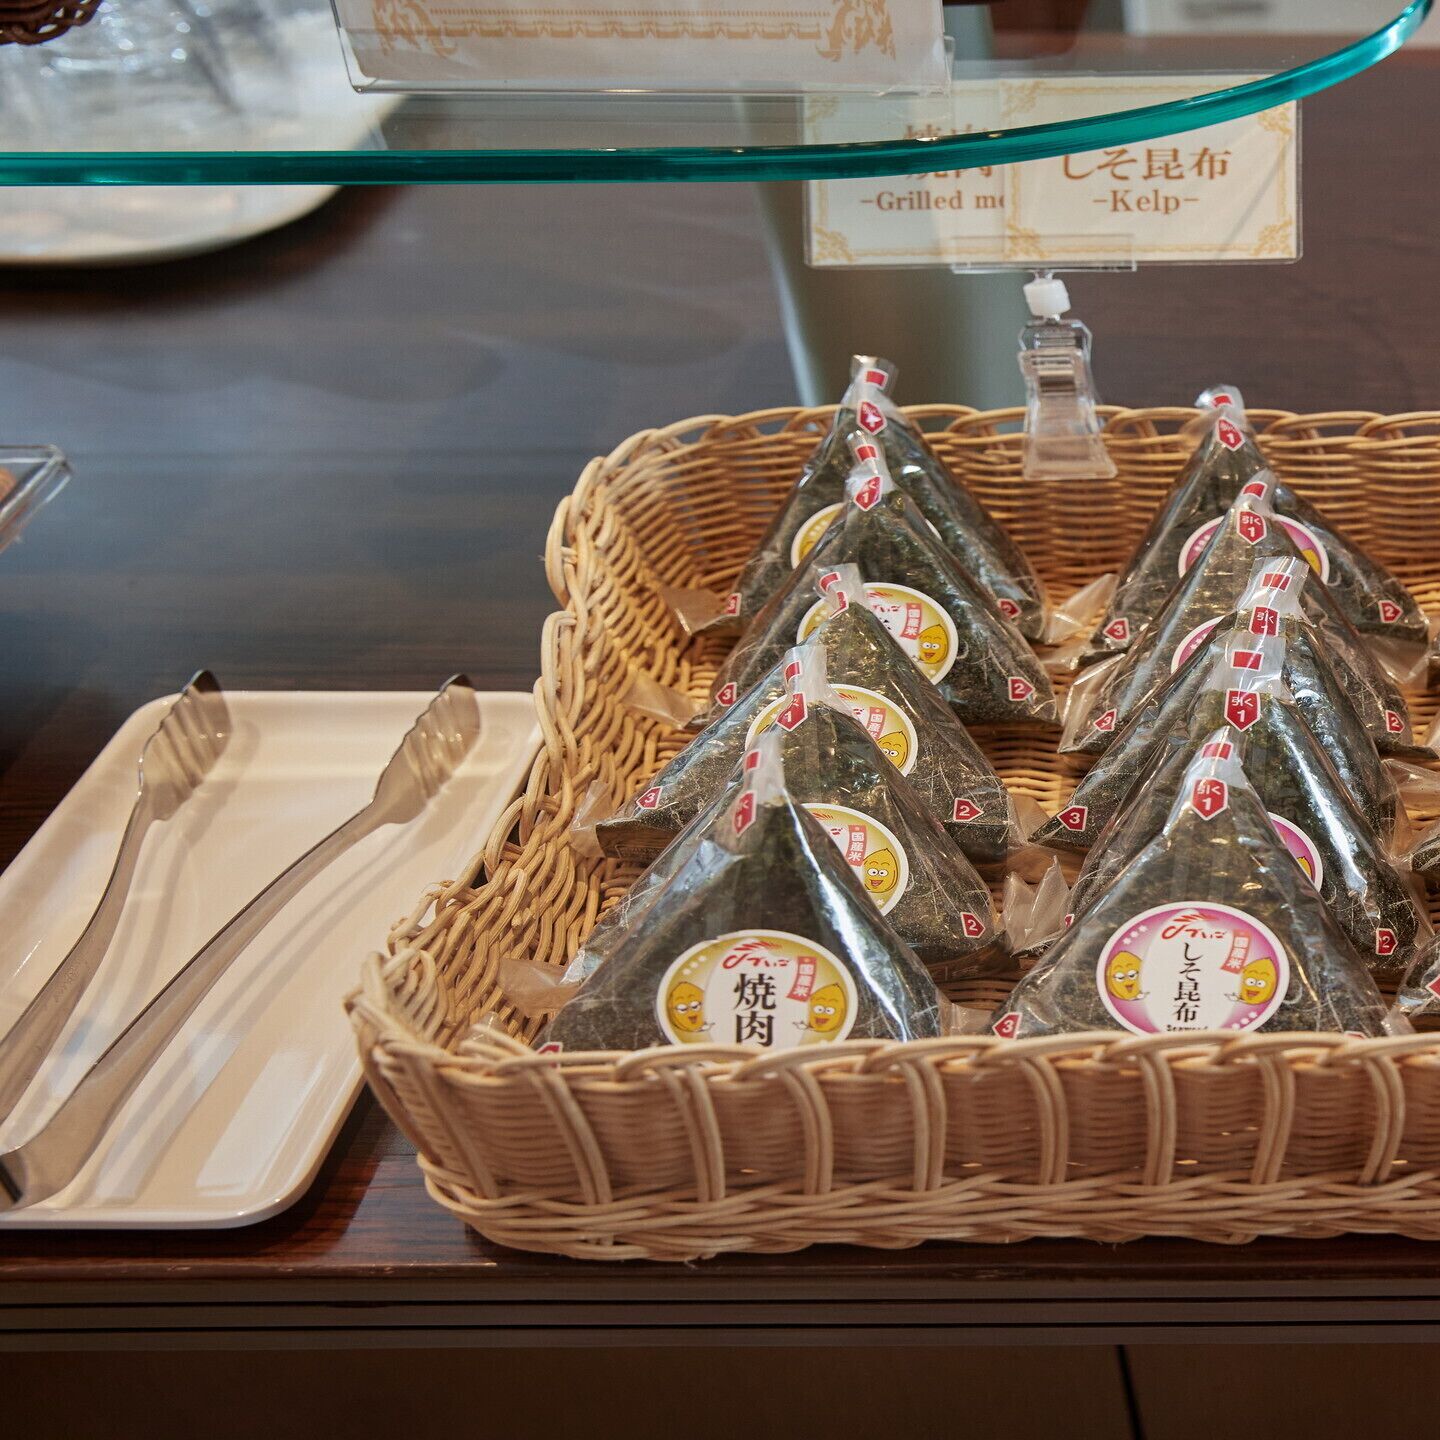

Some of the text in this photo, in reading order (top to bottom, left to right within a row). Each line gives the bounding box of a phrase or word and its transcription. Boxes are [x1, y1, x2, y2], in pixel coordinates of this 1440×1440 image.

[1062, 147, 1232, 181] しそ昆布
[1227, 433, 1235, 444] 1
[1242, 516, 1261, 525] 引く
[1248, 527, 1255, 538] 1
[1384, 605, 1394, 617] 2
[1114, 625, 1123, 636] 3
[1014, 683, 1024, 694] 2
[724, 689, 731, 700] 3
[1232, 696, 1254, 707] 引く
[784, 710, 792, 722] 1
[1100, 716, 1112, 726] 3
[1237, 710, 1245, 722] 1
[1391, 717, 1399, 727] 2
[1197, 784, 1221, 795] 引く
[644, 792, 655, 803] 3
[1202, 798, 1211, 810] 1
[959, 805, 970, 816] 2
[1070, 812, 1080, 824] 3
[967, 919, 978, 931] 2
[1382, 936, 1390, 948] 2
[1172, 942, 1203, 1023] しそ昆布
[733, 973, 776, 1047] 焼肉
[1002, 1020, 1013, 1033] 3
